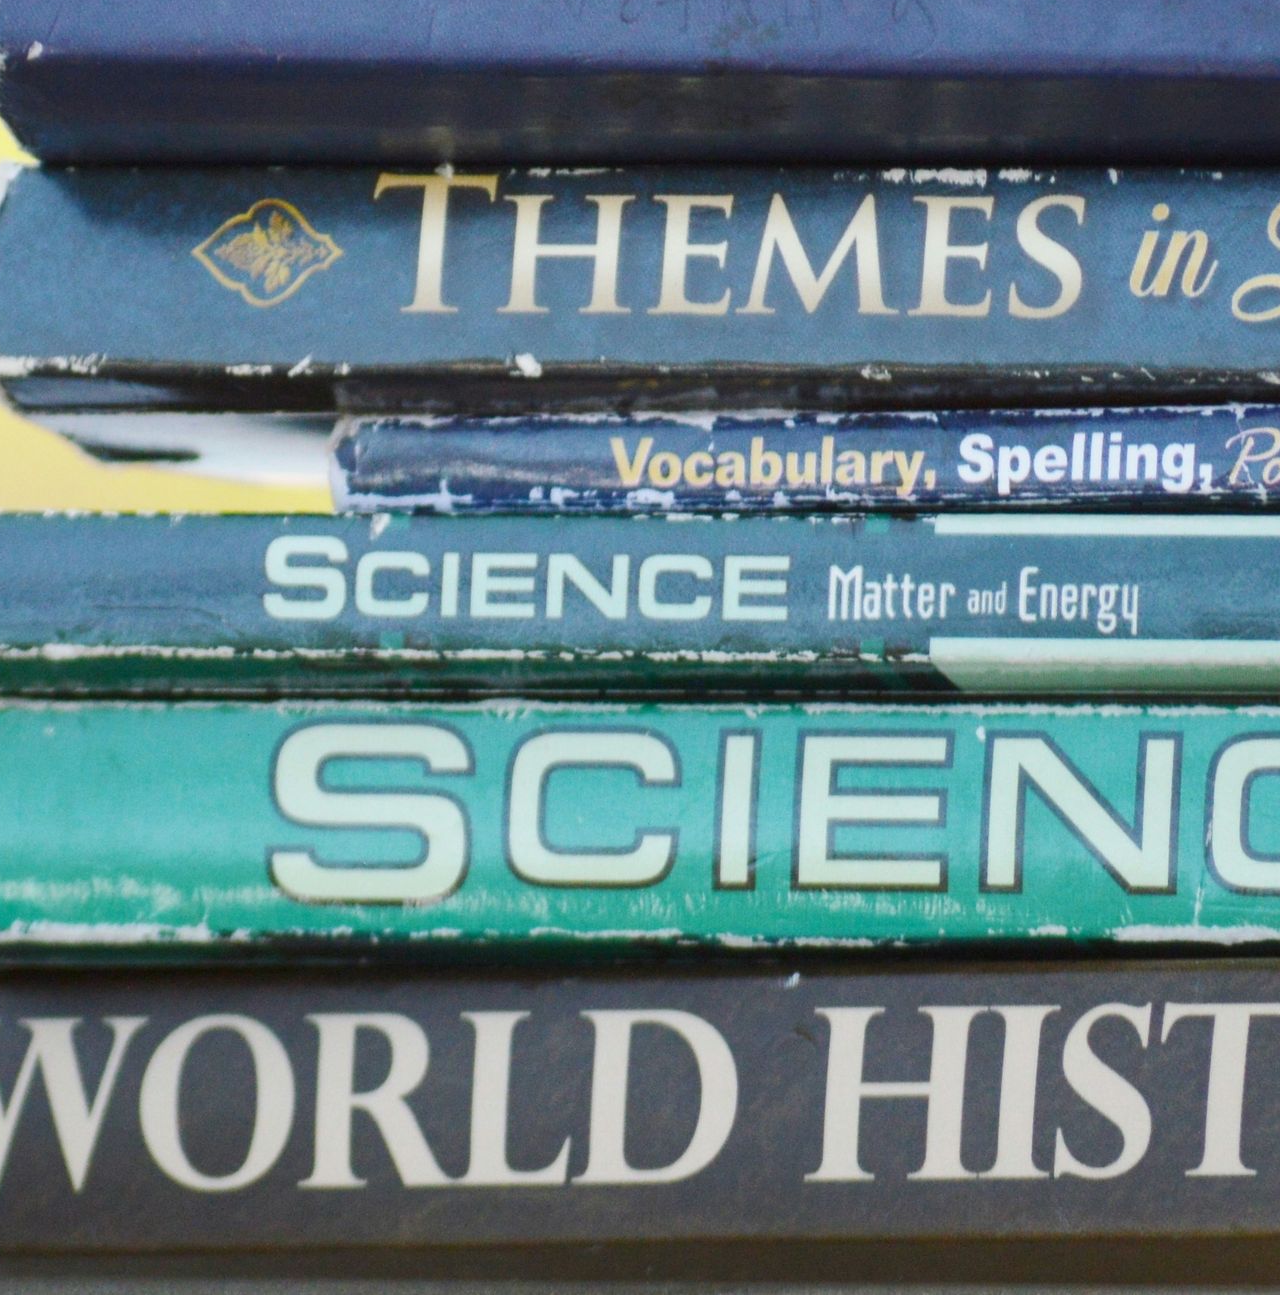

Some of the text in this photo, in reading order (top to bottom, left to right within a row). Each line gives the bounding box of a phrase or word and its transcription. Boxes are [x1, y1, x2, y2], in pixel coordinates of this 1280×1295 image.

[375, 172, 1085, 320] THEMES
[1129, 205, 1217, 297] in
[610, 437, 936, 495] Vocabulary,
[958, 433, 1214, 494] Spelling,
[263, 535, 791, 621] SCIENCE
[828, 566, 955, 620] Matter
[967, 582, 1007, 614] and
[1018, 567, 1138, 634] Energy
